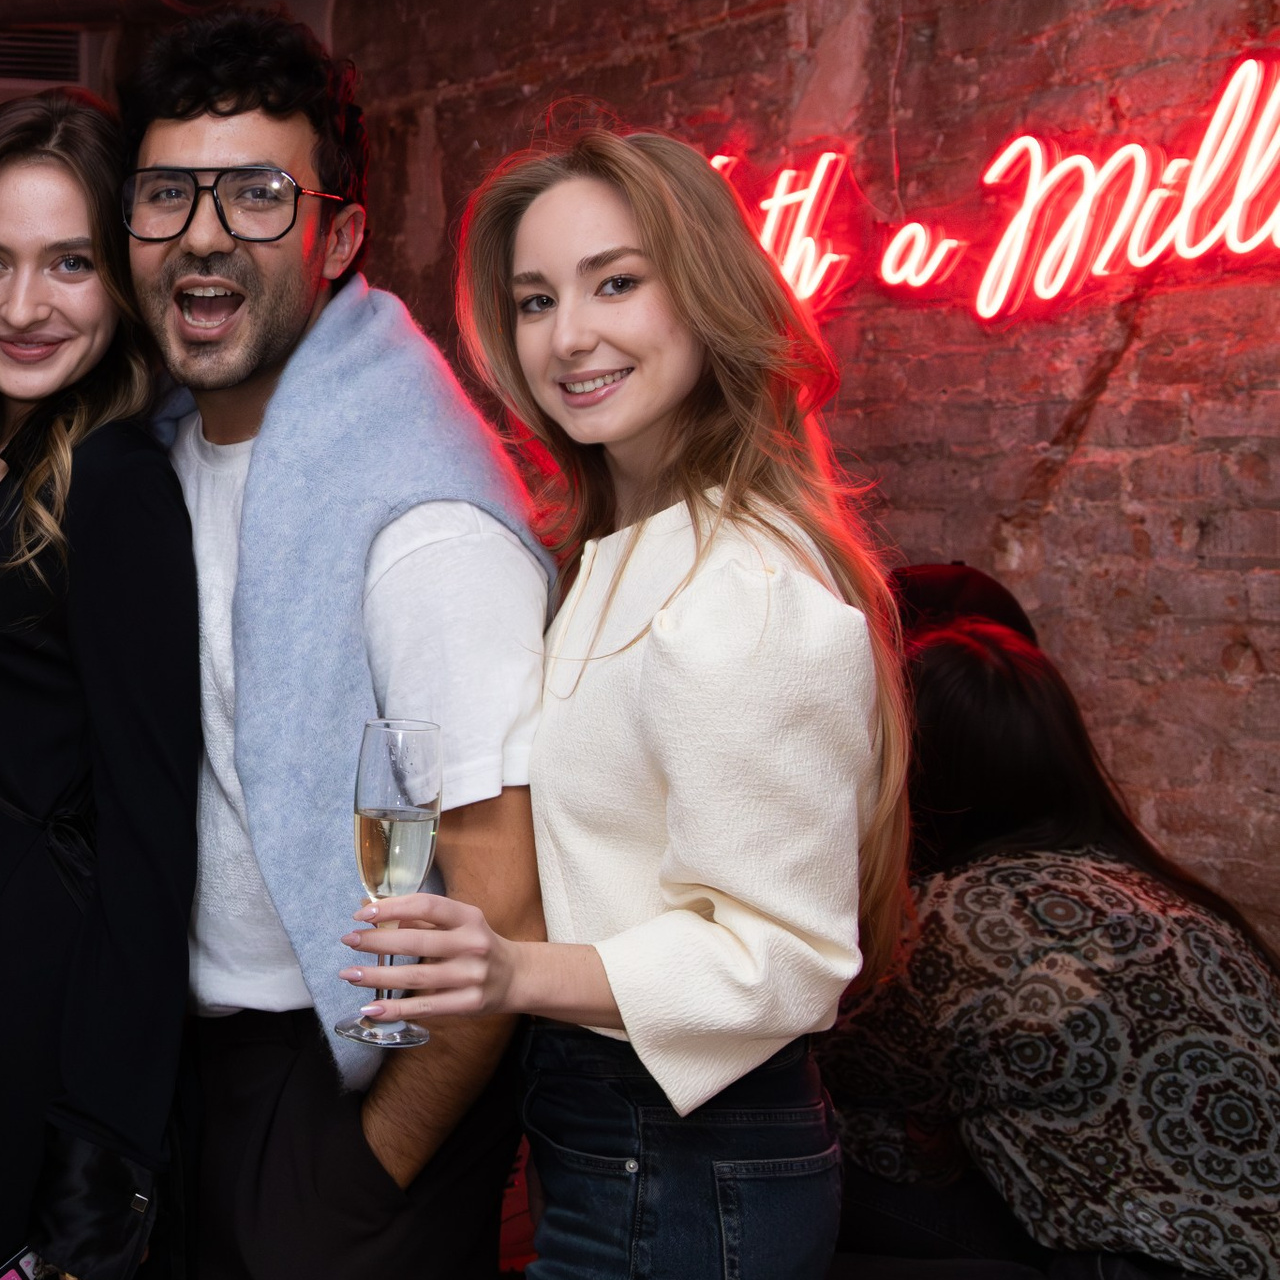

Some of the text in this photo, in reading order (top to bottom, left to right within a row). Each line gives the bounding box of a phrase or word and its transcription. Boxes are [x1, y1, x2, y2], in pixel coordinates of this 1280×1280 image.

[710, 58, 1280, 319] th a Mill
